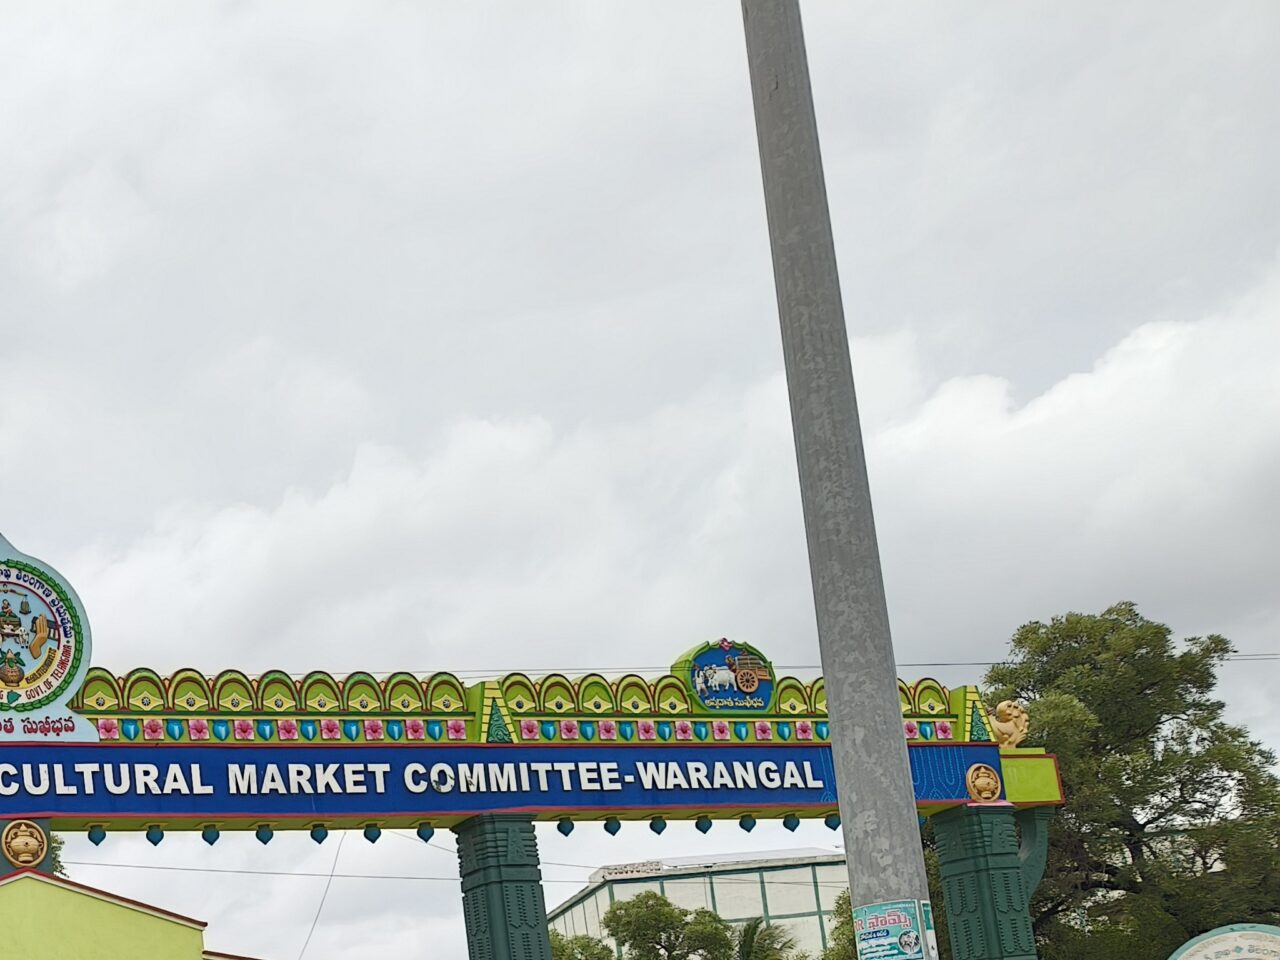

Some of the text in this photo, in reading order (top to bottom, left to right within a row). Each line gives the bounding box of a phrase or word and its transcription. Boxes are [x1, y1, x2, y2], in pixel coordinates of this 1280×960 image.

[25, 644, 72, 700] GOVT. OF TELANGANA
[21, 715, 76, 738] సుఖీభవ
[227, 763, 391, 794] MARKET
[403, 760, 824, 794] COMMITTEE-WARANGAL
